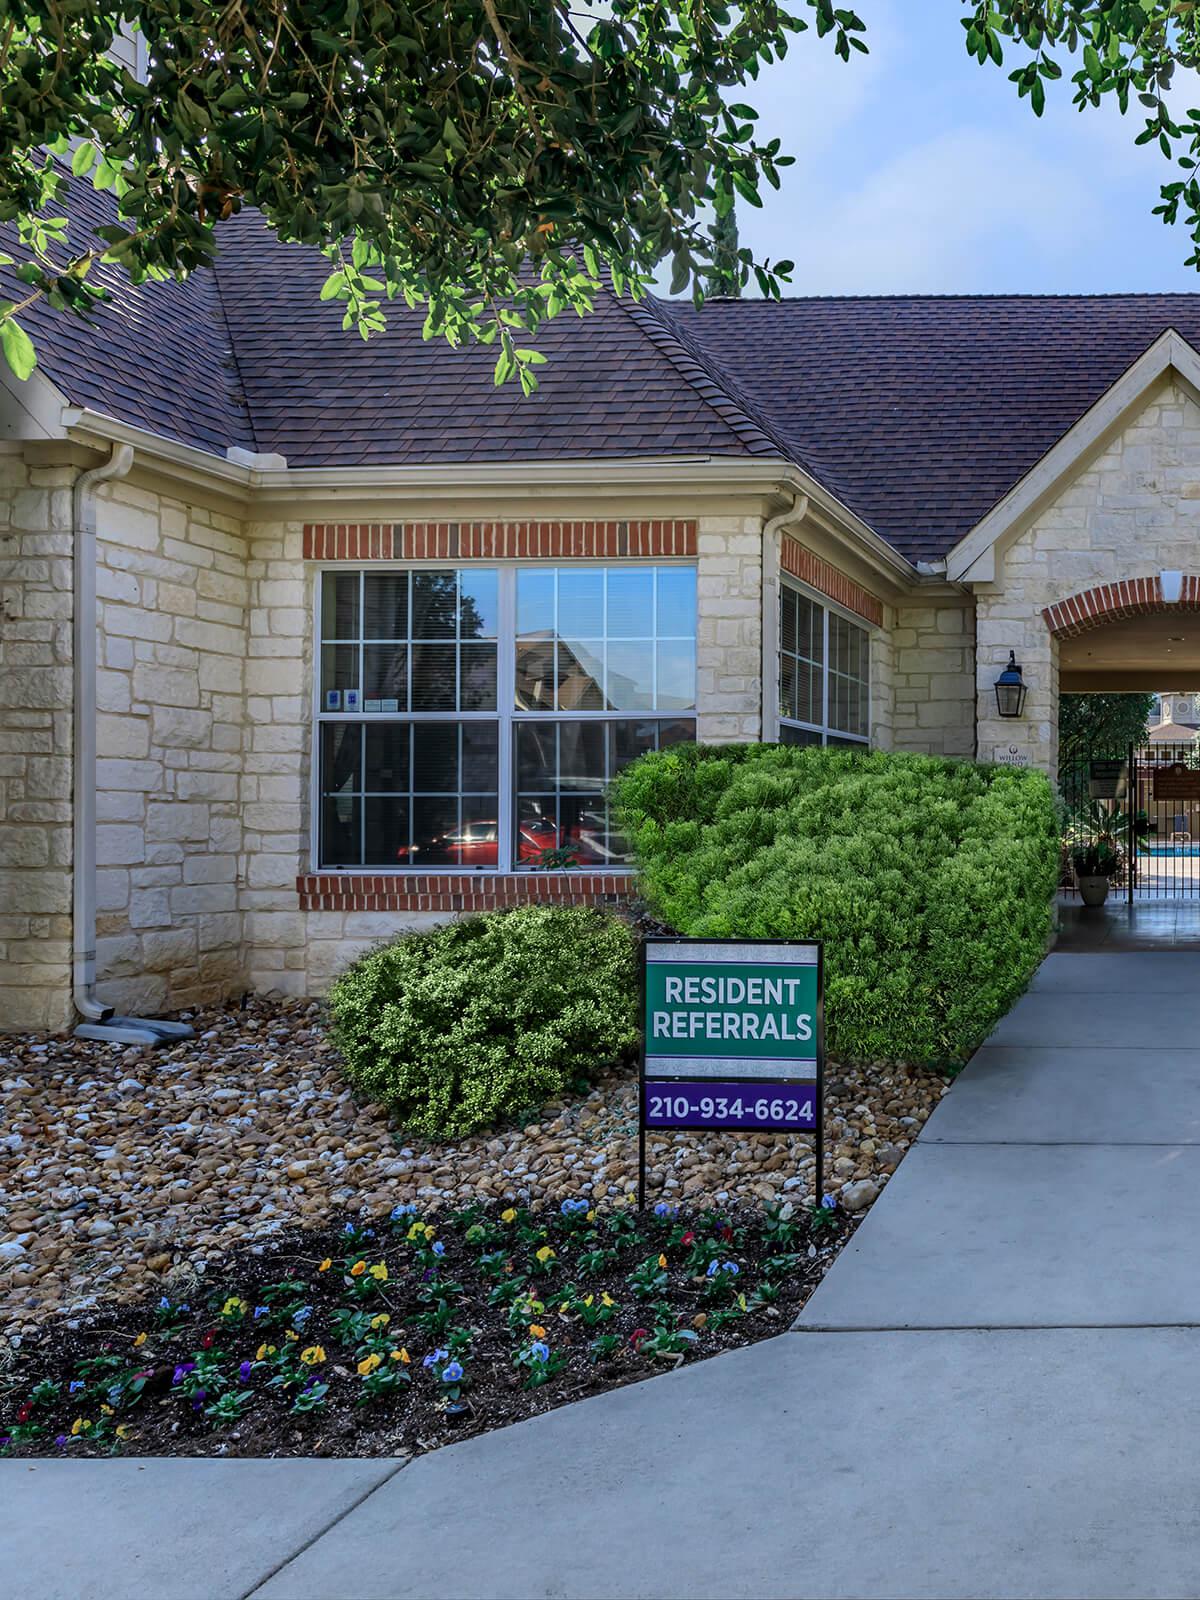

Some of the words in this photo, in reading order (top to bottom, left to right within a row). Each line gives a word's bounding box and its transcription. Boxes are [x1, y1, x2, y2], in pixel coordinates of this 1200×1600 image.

[665, 976, 800, 1006] RESIDENT
[653, 1011, 812, 1041] REFERRALS
[649, 1096, 814, 1121] 210-934-6624
